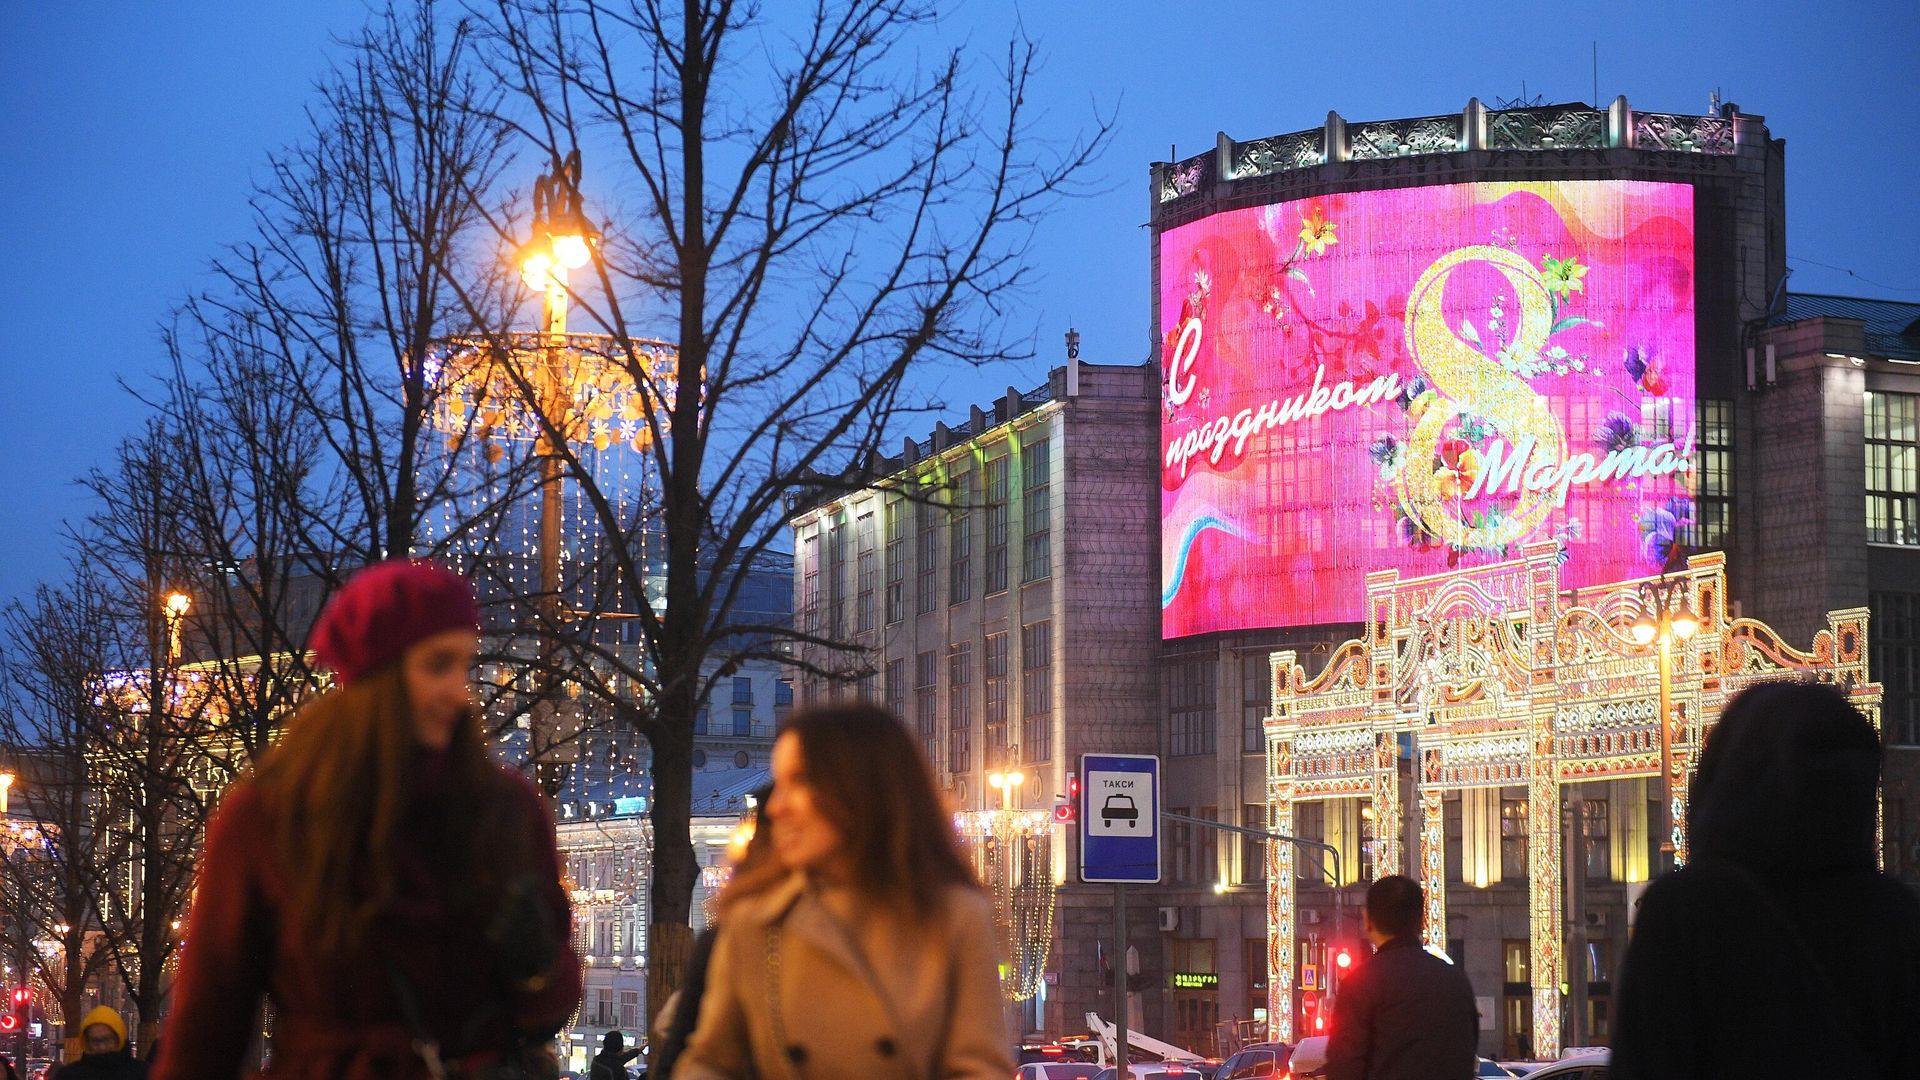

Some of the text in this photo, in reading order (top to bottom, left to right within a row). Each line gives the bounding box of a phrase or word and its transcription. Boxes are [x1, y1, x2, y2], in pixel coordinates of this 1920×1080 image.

[1170, 318, 1202, 405] С
[1397, 245, 1567, 546] 8
[1166, 364, 1402, 478] праздником
[1465, 422, 1696, 507] Марта!
[1103, 780, 1134, 788] ТАКСИ
